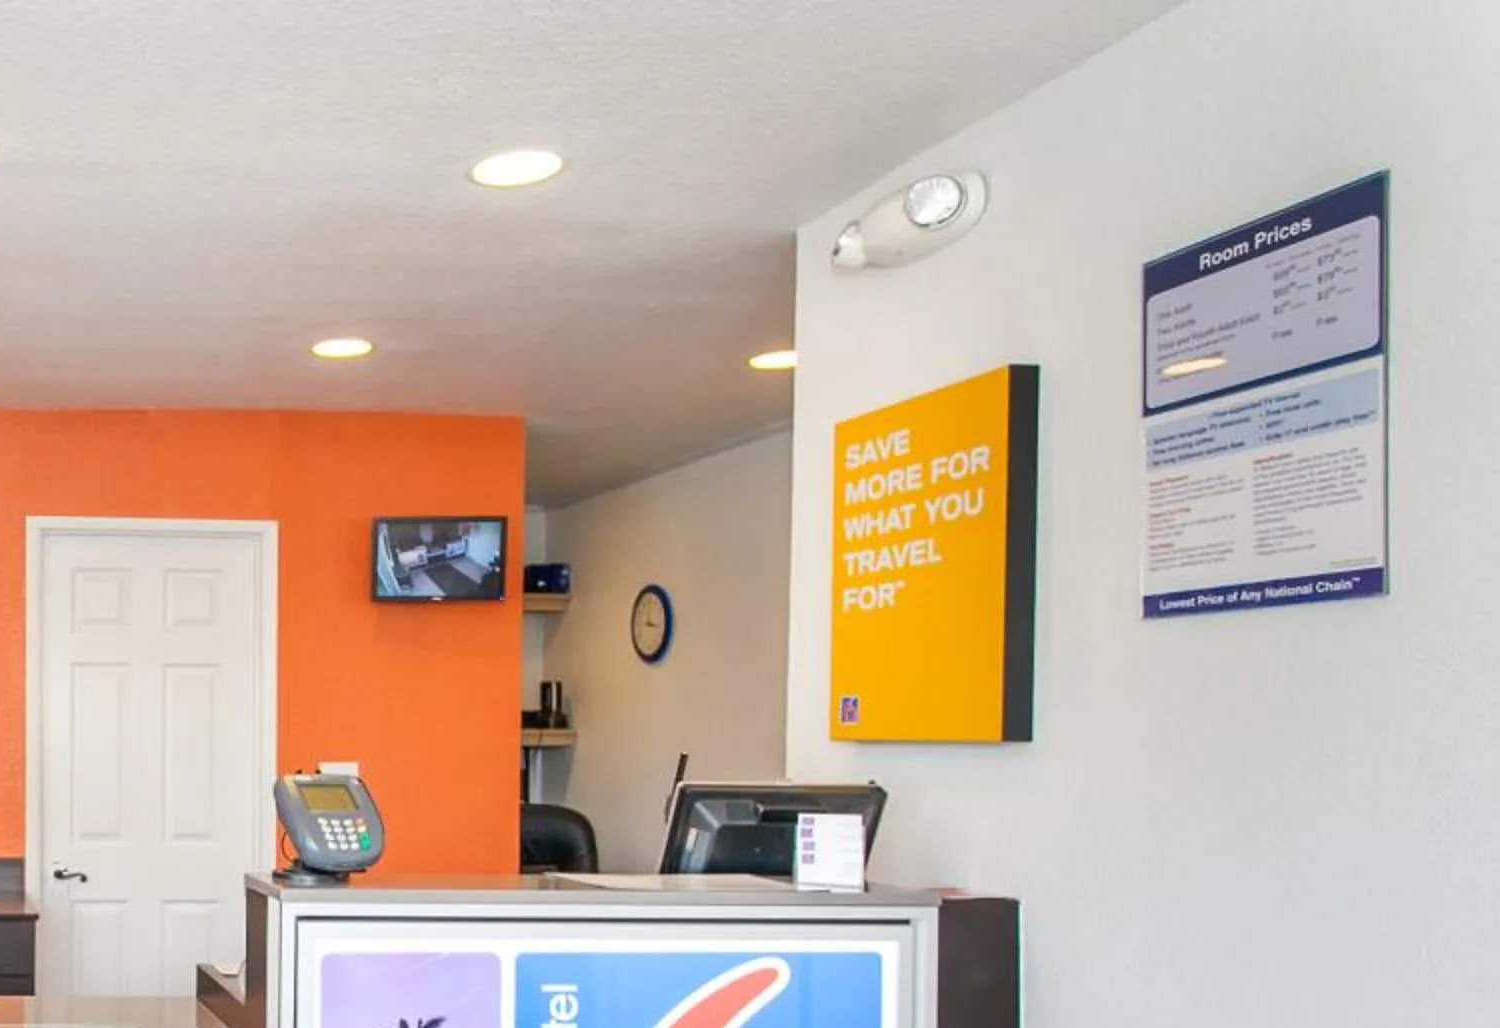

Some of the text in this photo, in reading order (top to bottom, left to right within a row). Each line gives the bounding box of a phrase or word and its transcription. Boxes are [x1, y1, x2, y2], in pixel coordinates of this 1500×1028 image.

[1199, 241, 1249, 271] Room
[1254, 217, 1312, 250] Prices
[845, 429, 910, 469] SAVE
[845, 444, 990, 506] MORE FOR
[843, 488, 984, 541] WHAT YOU
[843, 538, 942, 576] TRAVEL
[1160, 595, 1196, 611] Lowest
[1197, 592, 1224, 607] Price
[1226, 591, 1238, 603] of
[1240, 589, 1261, 603] Any
[1265, 582, 1313, 599] National
